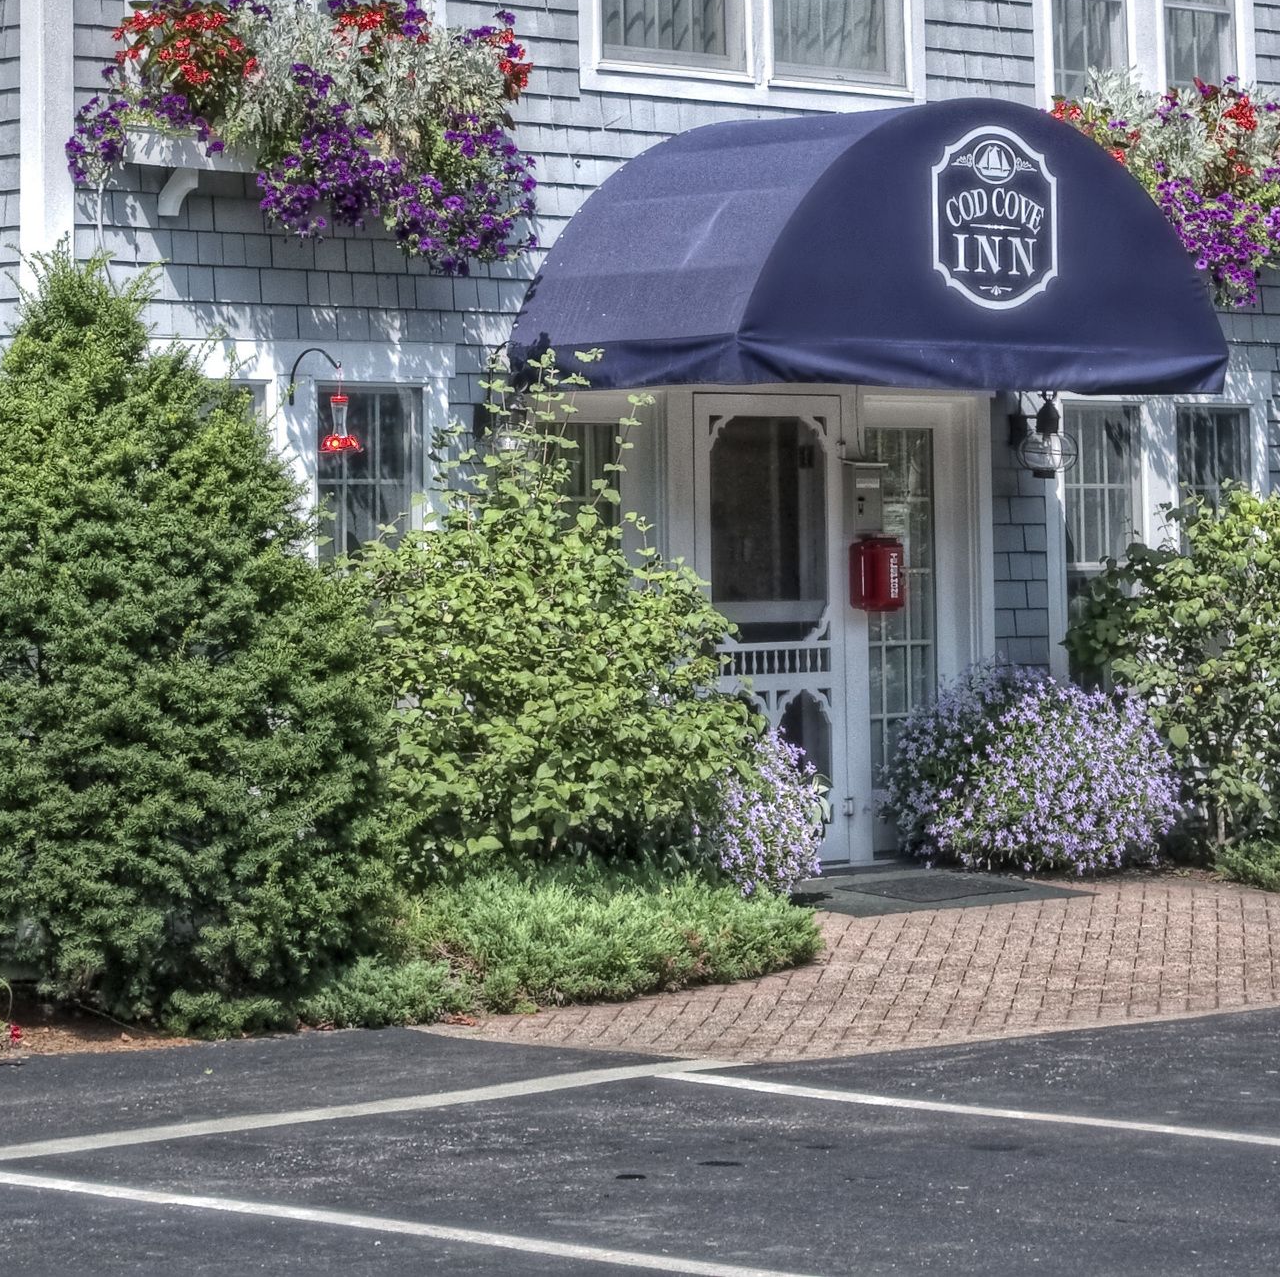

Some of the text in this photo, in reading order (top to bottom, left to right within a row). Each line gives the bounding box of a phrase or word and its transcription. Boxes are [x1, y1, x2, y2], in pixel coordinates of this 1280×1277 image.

[945, 187, 1045, 235] COD COVE
[952, 233, 1037, 277] INN
